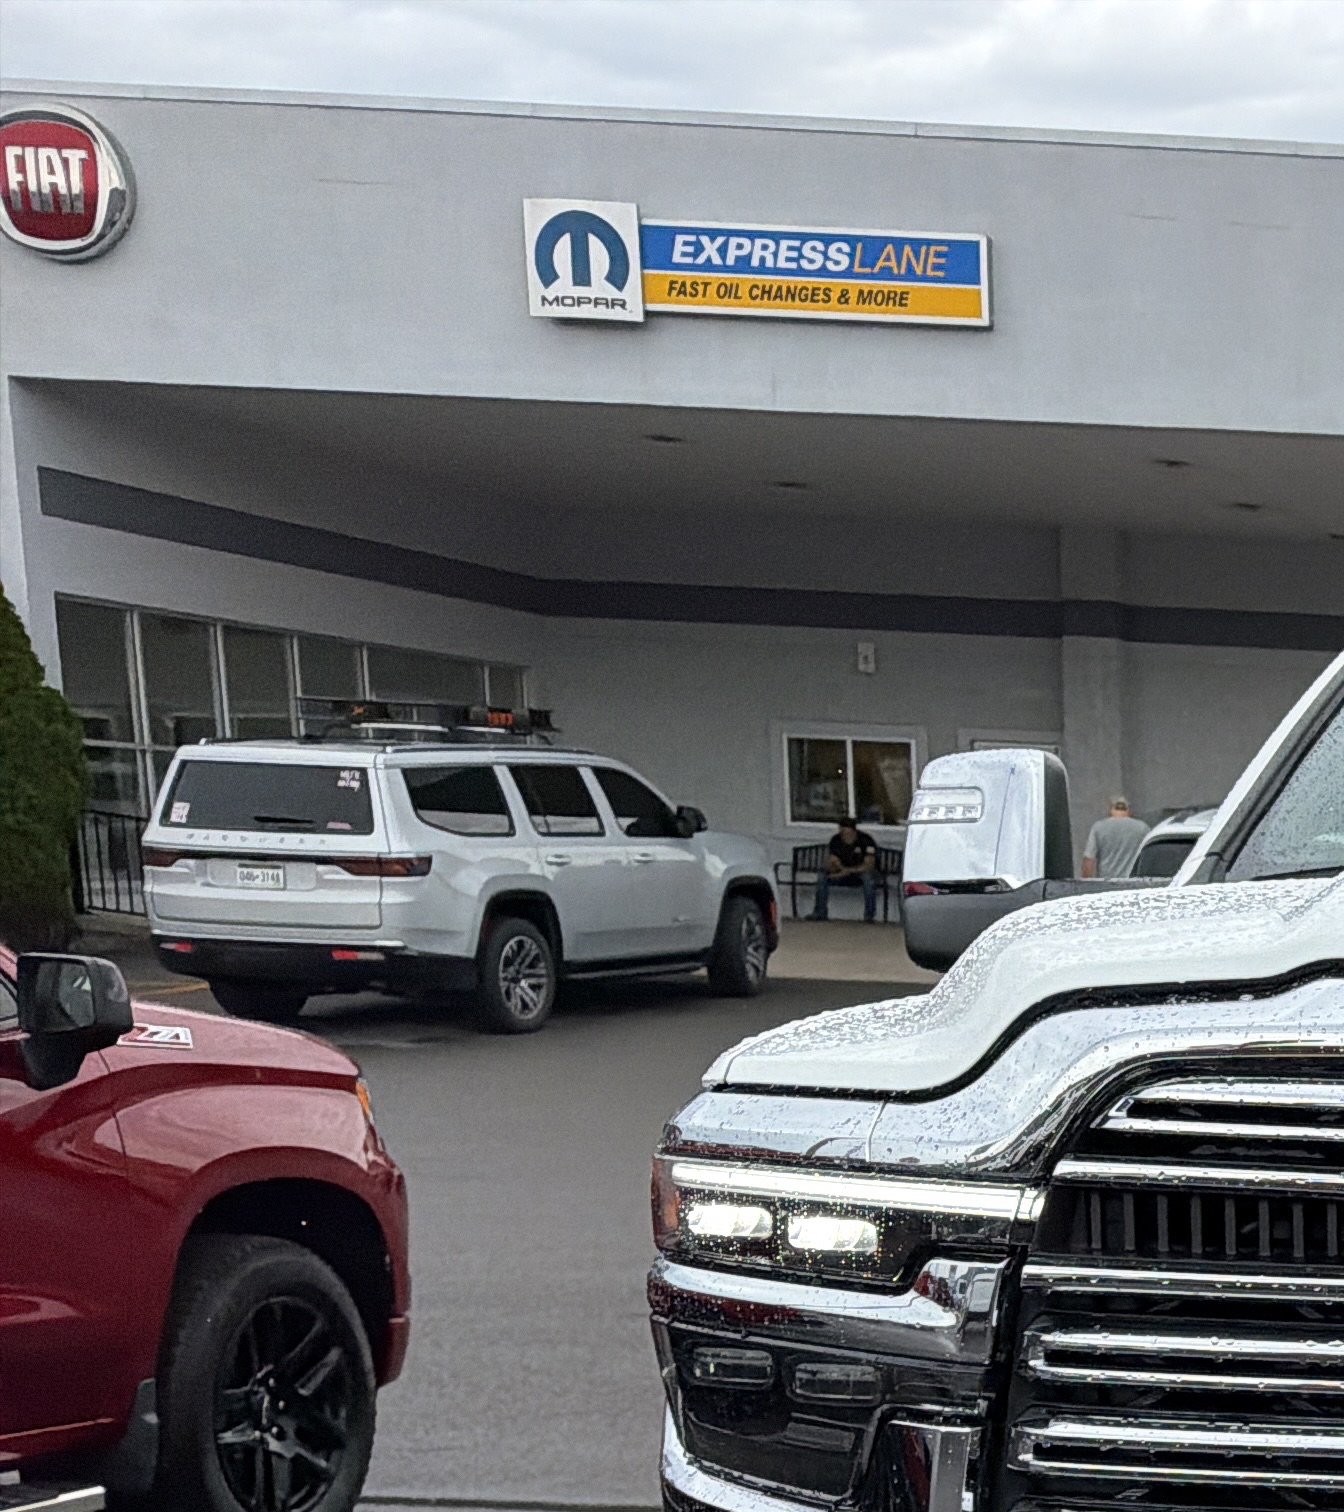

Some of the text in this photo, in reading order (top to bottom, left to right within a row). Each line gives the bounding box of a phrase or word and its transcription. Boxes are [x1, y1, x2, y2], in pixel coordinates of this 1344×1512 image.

[5, 146, 88, 215] FIAT
[540, 295, 628, 311] MOPAR
[667, 279, 910, 308] FAST OIL CHANGES & MORE
